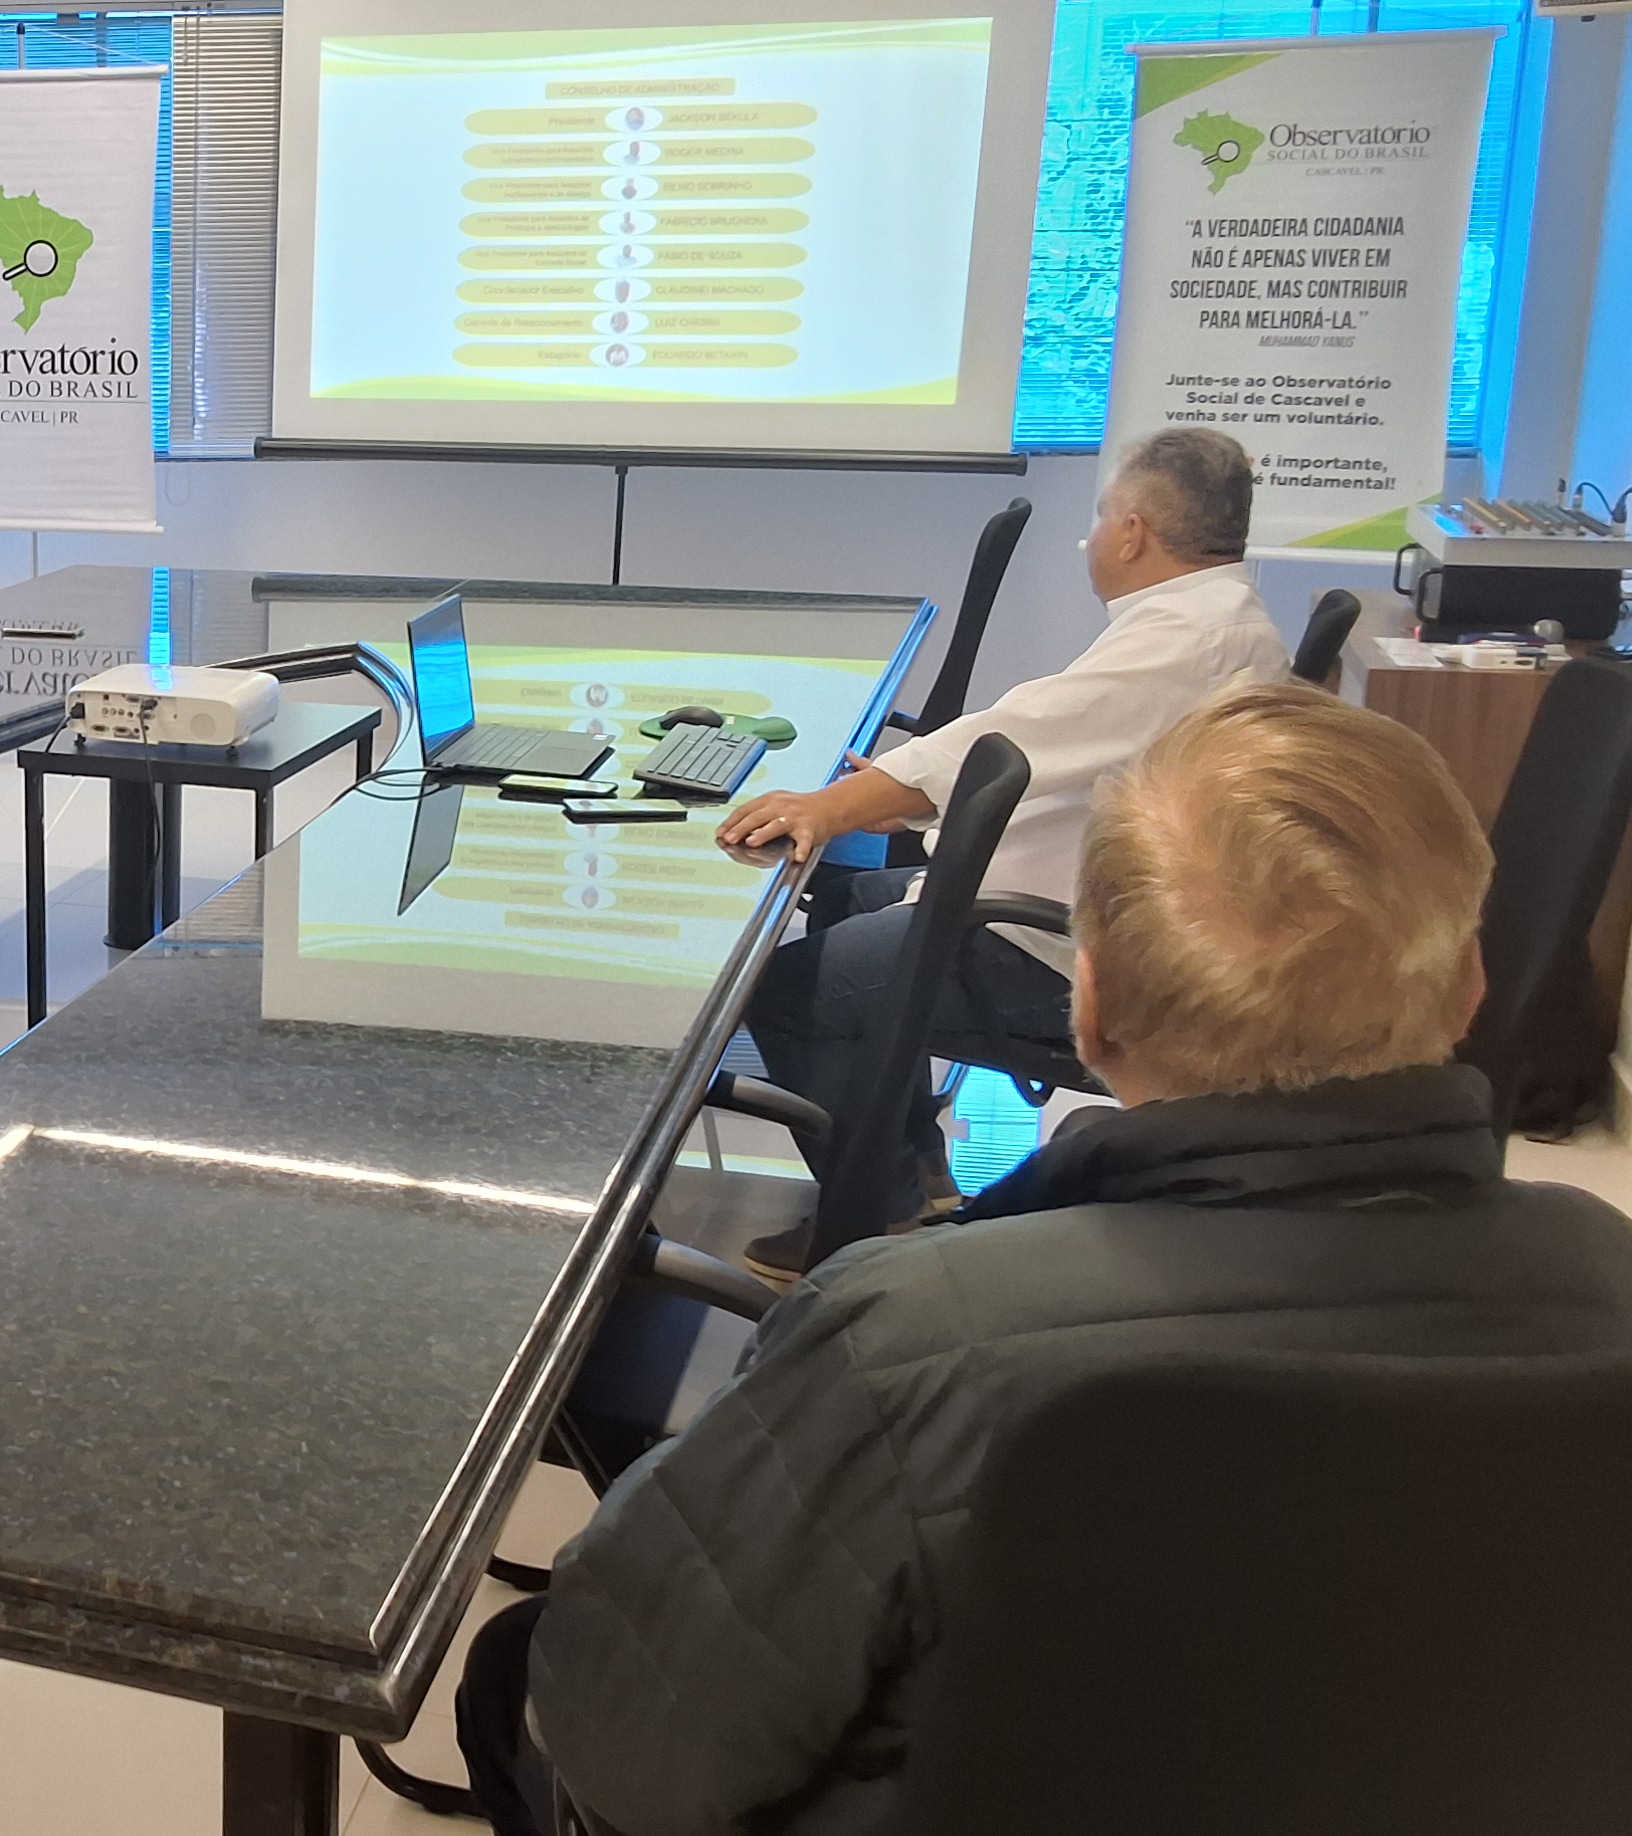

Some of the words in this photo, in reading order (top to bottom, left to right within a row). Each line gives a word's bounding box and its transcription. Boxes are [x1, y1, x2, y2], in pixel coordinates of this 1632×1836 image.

[1270, 119, 1431, 148] Observatório
[1267, 149, 1329, 161] SOCIAL
[1335, 148, 1359, 160] DO
[1365, 146, 1429, 159] BRASIL
[1305, 167, 1362, 176] CASCAVEL
[1371, 166, 1385, 175] PR
[1208, 218, 1309, 238] VERDADEIRA
[1313, 216, 1405, 237] CIDADANIA
[1191, 246, 1224, 268] NÃO
[1227, 245, 1238, 268] É
[1241, 249, 1306, 268] APENAS
[1311, 248, 1360, 267] VIVER
[1365, 248, 1391, 267] EM
[1169, 279, 1262, 301] SOCIEDADE,
[1267, 279, 1303, 299] MAS
[1307, 279, 1408, 299] CONTRIBUIR
[1199, 310, 1240, 329] PARA
[8, 380, 41, 397] DO
[50, 380, 139, 398] BRASIL
[1165, 373, 1240, 388] Junte-se
[1245, 376, 1266, 388] ao
[1271, 374, 1392, 390] Observatório
[1186, 391, 1238, 405] Social
[1243, 391, 1265, 405] de
[1271, 393, 1350, 408] Cascavel
[1355, 397, 1366, 408] e
[60, 410, 79, 424] PR
[1165, 409, 1217, 423] venha
[1221, 412, 1248, 423] ser
[1253, 413, 1280, 424] um
[1286, 411, 1385, 426] voluntário.
[1261, 453, 1271, 467] é
[1276, 454, 1388, 474] importante,
[1254, 472, 1264, 485] é
[1270, 472, 1396, 490] fundamental!
